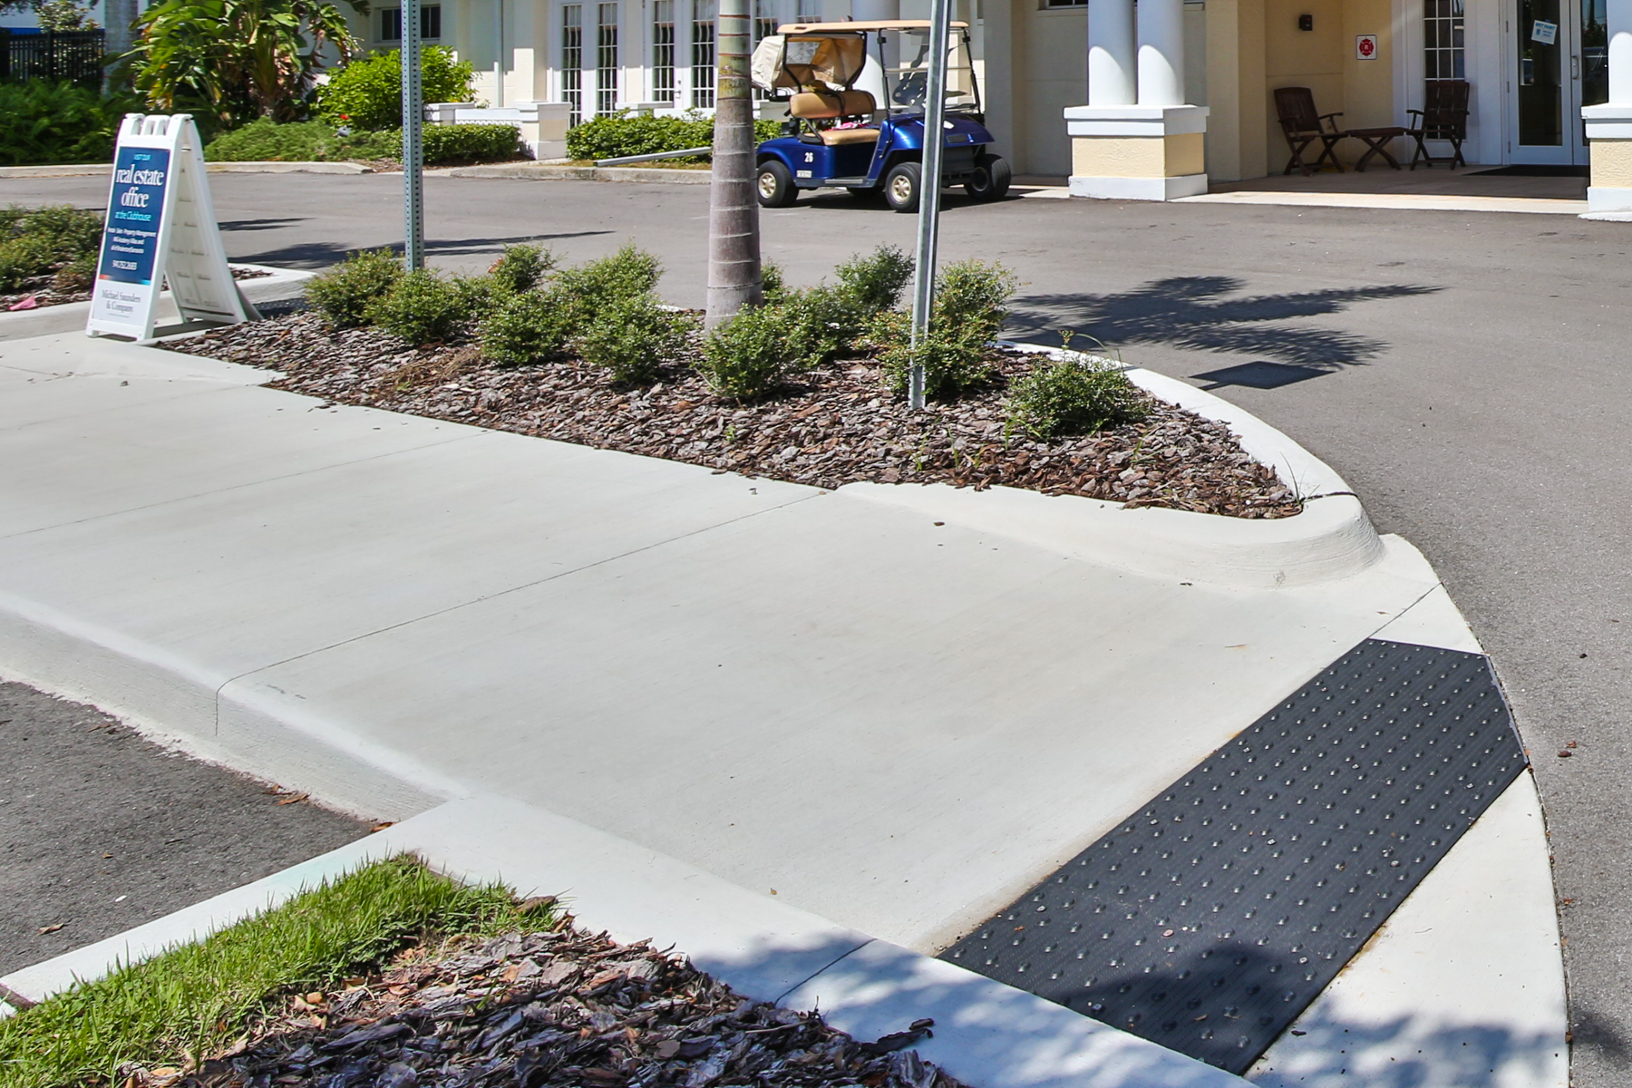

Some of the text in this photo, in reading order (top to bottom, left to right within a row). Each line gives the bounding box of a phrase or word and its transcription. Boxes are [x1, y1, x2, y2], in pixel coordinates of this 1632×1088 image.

[804, 152, 814, 162] 26
[116, 163, 165, 186] real estate
[121, 186, 150, 208] office
